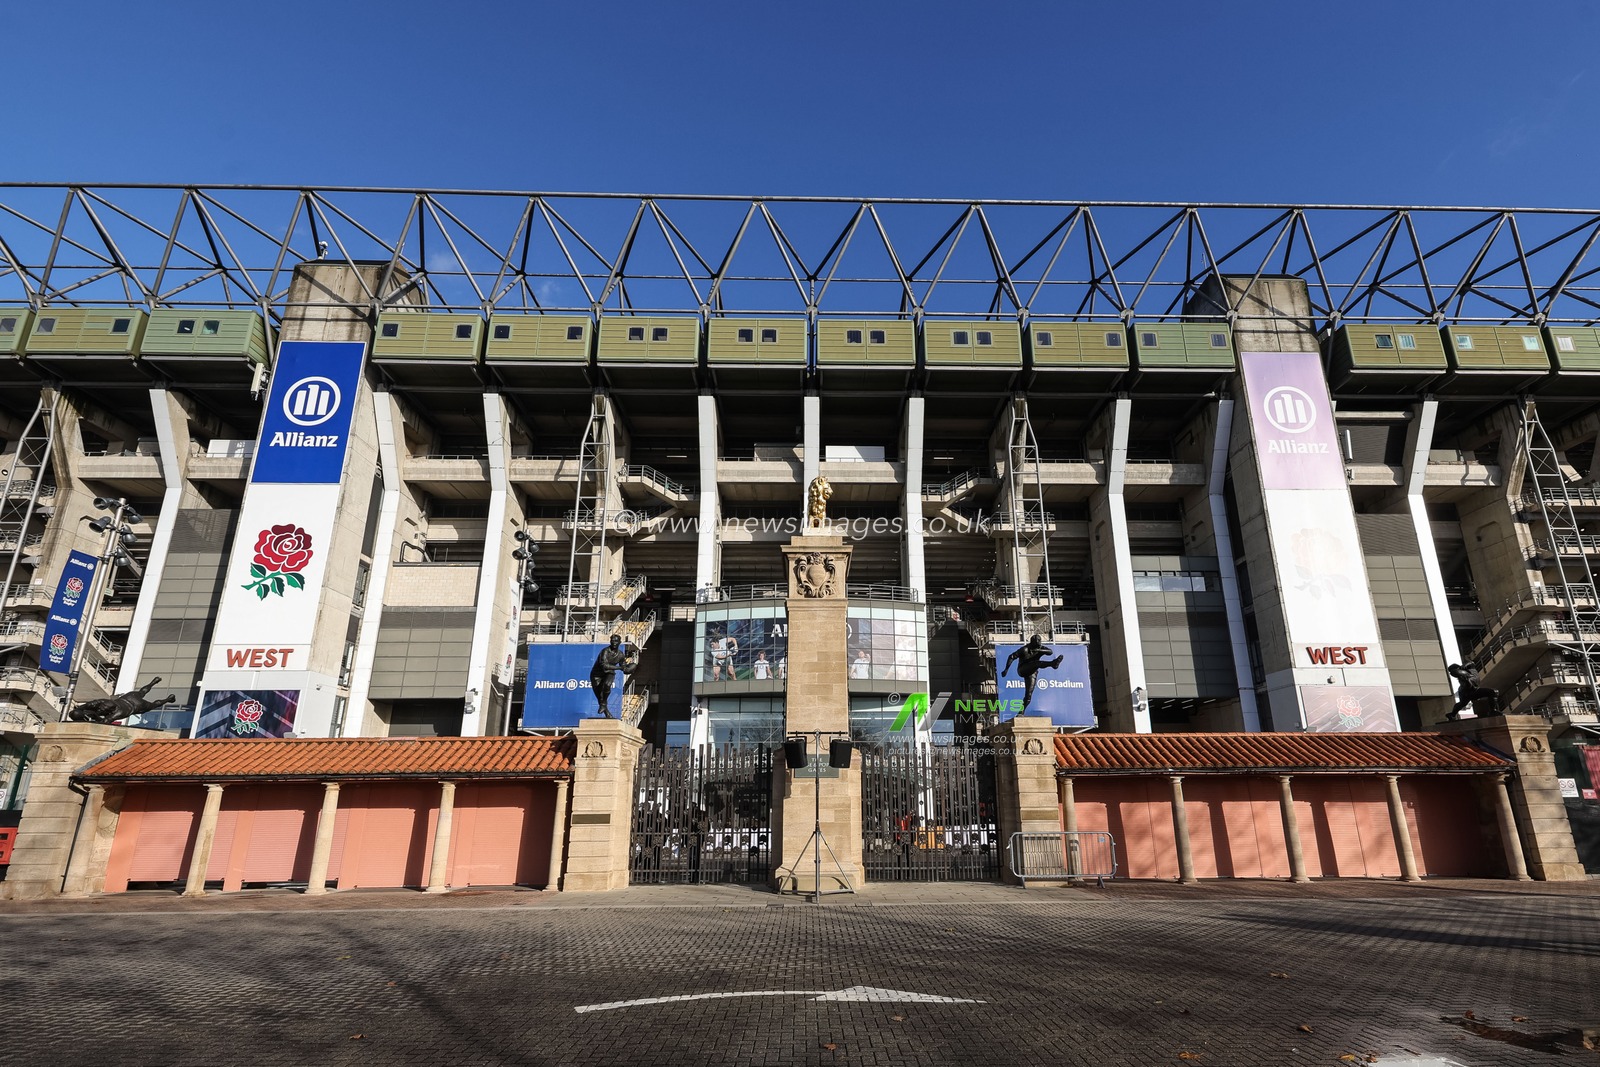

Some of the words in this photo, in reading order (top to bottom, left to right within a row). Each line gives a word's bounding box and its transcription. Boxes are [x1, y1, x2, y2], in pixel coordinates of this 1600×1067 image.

[269, 431, 339, 448] Allianz
[1268, 439, 1330, 454] Allianz
[69, 558, 88, 568] Allianz
[51, 614, 70, 624] Allianz
[226, 648, 294, 668] WEST
[1306, 646, 1368, 665] WEST
[534, 680, 565, 689] Allianz
[579, 680, 616, 689] Stam
[1005, 680, 1026, 689] Allia
[1049, 679, 1084, 689] Stadium
